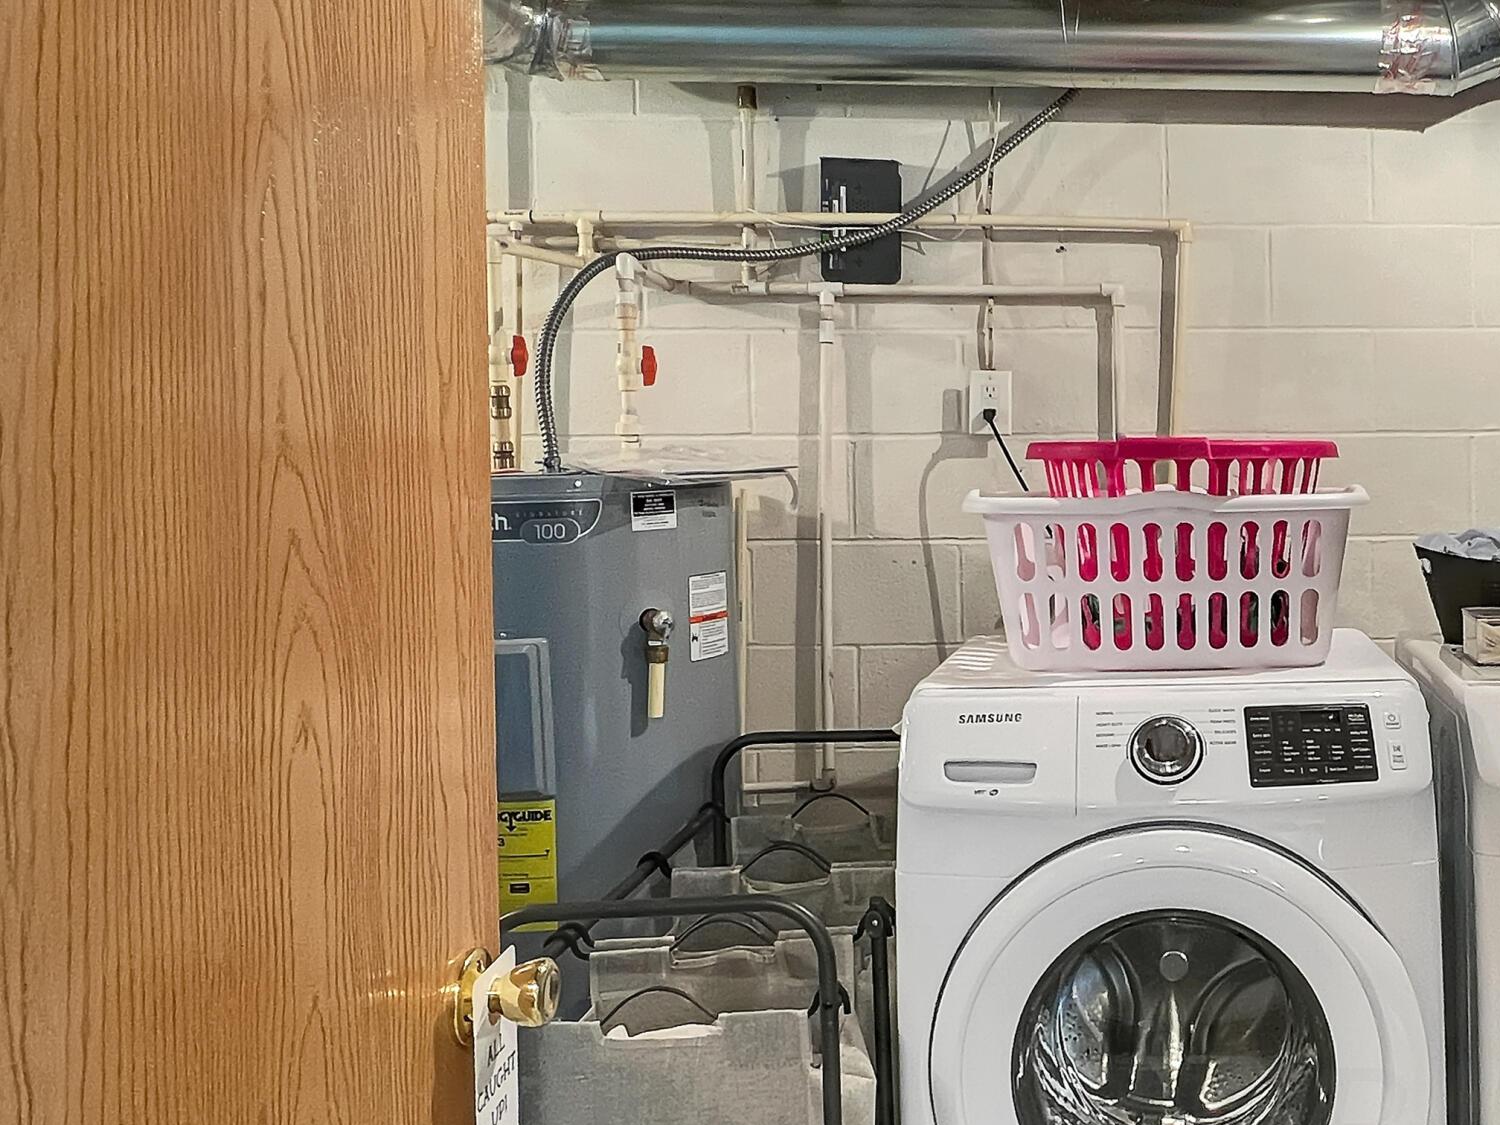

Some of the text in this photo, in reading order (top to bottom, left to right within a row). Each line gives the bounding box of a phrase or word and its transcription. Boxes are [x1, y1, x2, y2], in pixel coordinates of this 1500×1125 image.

[533, 523, 566, 540] 100
[958, 712, 1023, 724] SAMSUNG
[487, 1032, 506, 1068] ALL
[477, 1049, 516, 1113] CAUGHT
